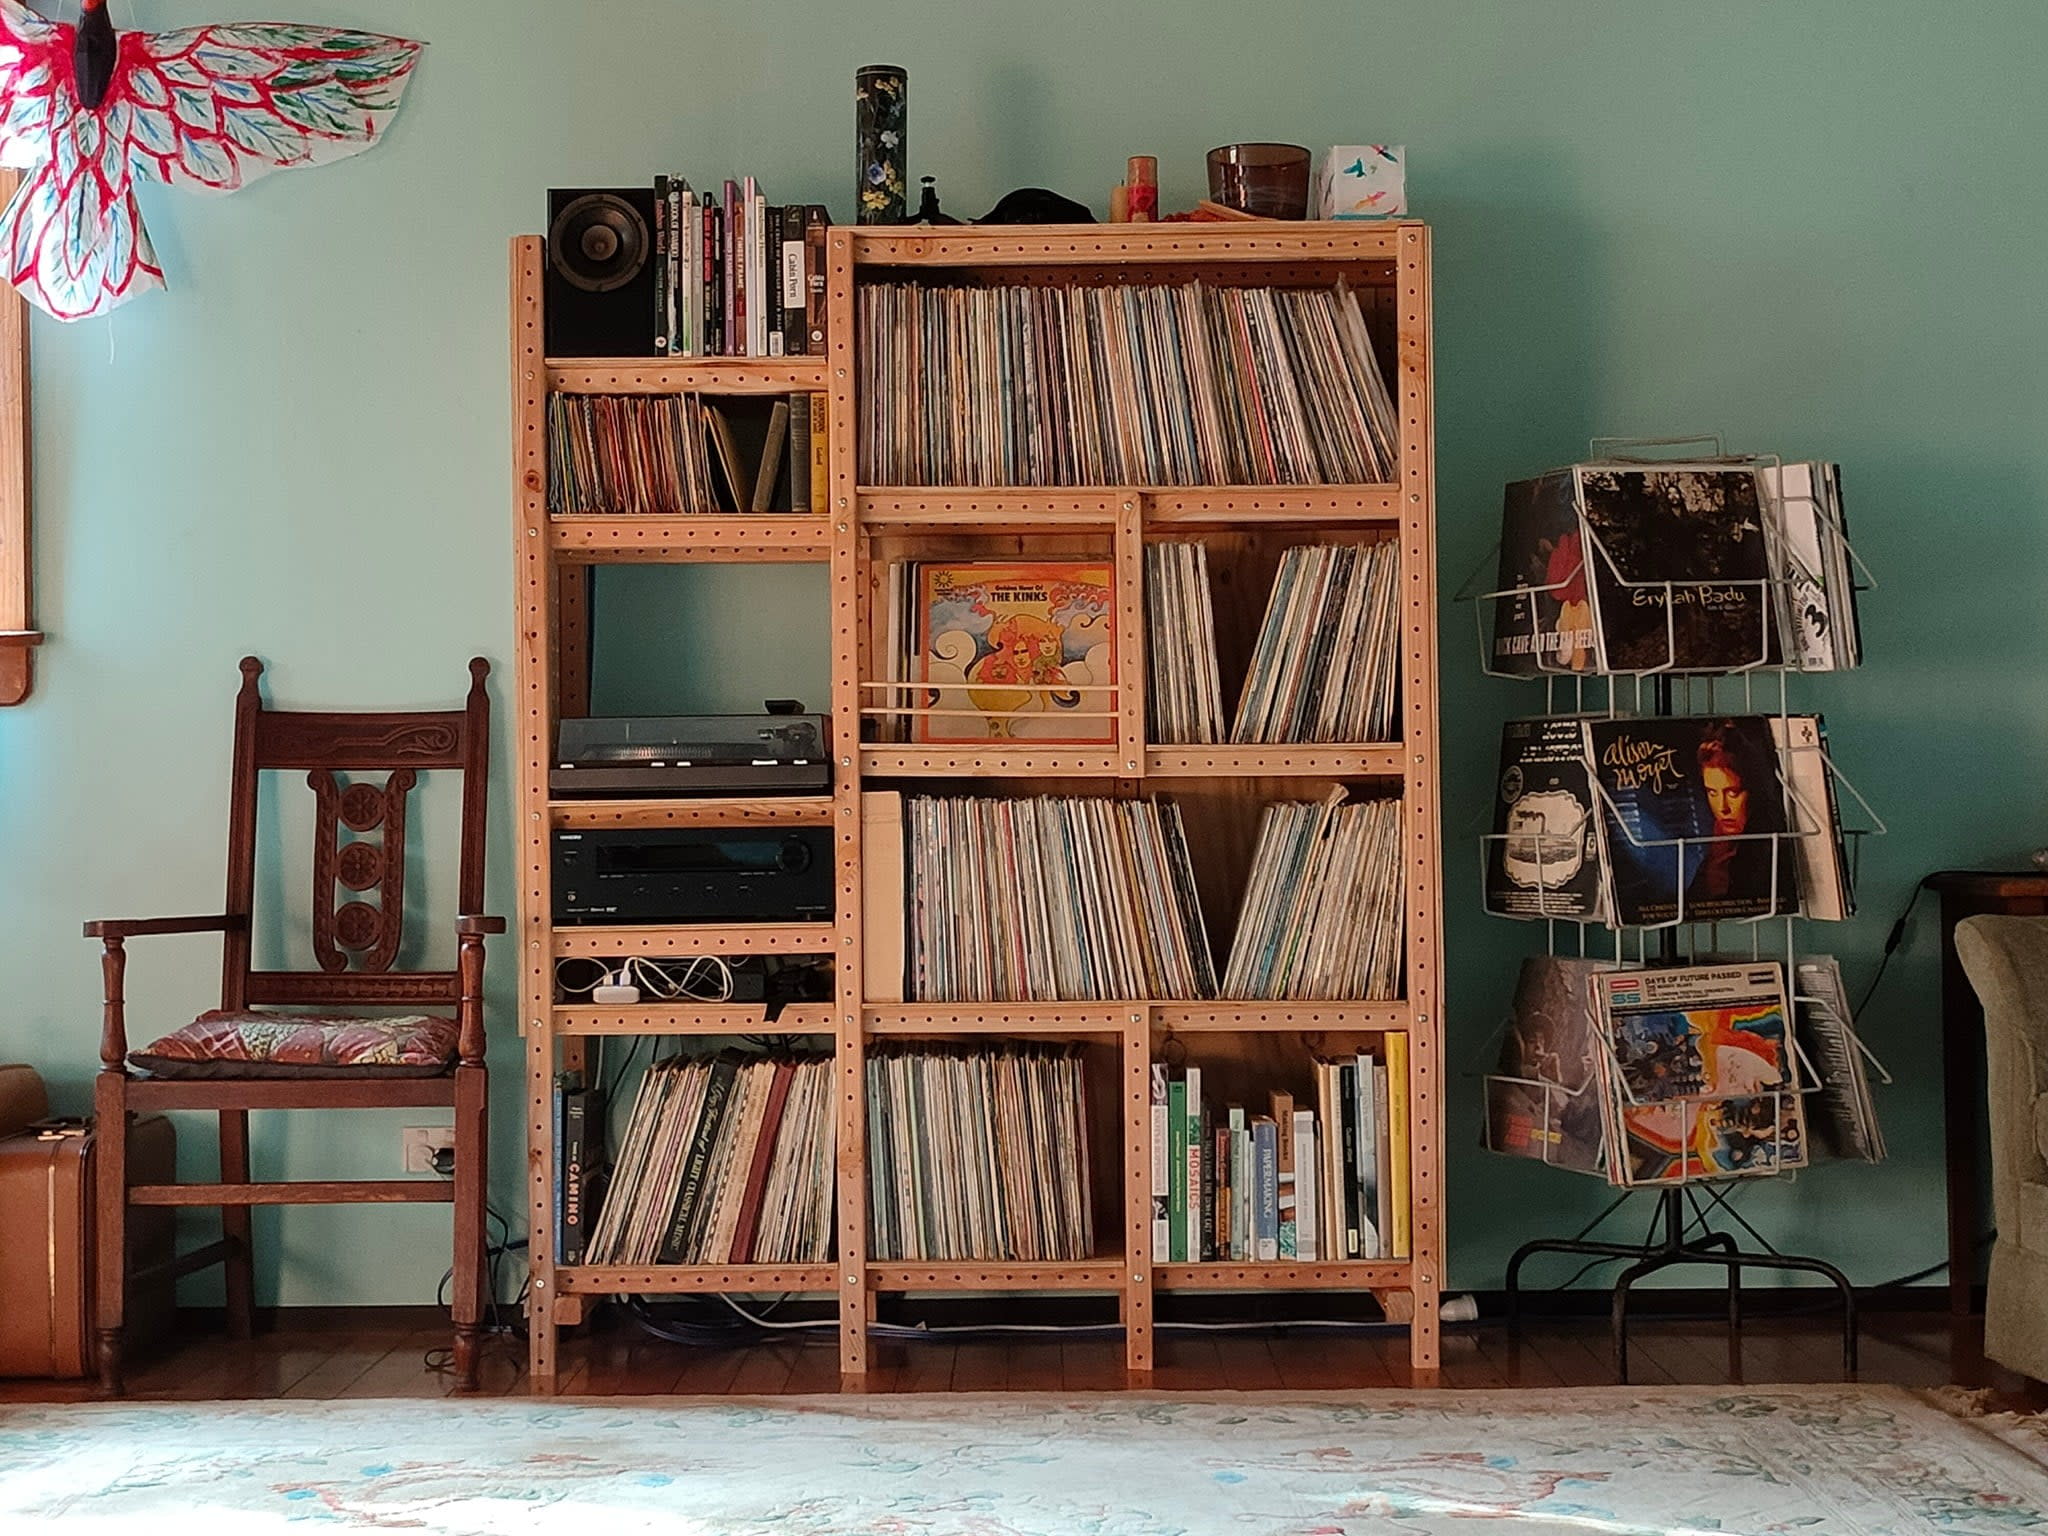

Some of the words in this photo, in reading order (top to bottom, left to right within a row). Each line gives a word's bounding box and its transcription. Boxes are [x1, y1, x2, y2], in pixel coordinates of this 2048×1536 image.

[656, 231, 665, 255] World
[788, 253, 798, 278] Cabin
[788, 278, 798, 298] Porn
[991, 592, 1010, 602] THE
[1014, 591, 1048, 602] KINKS
[1697, 584, 1746, 607] Badu
[1645, 977, 1666, 985] DAYS
[1680, 974, 1710, 982] FUTURE
[1711, 971, 1742, 980] PASSED
[1280, 1110, 1290, 1137] Making
[1280, 1138, 1290, 1160] Books
[689, 1153, 705, 1180] LIGHT
[1189, 1148, 1199, 1209] MOSAICS
[567, 1163, 581, 1225] CAMINO
[1263, 1148, 1273, 1219] PAPERMAKING
[676, 1181, 697, 1223] CLASSICAL
[671, 1224, 685, 1250] MUSIC
